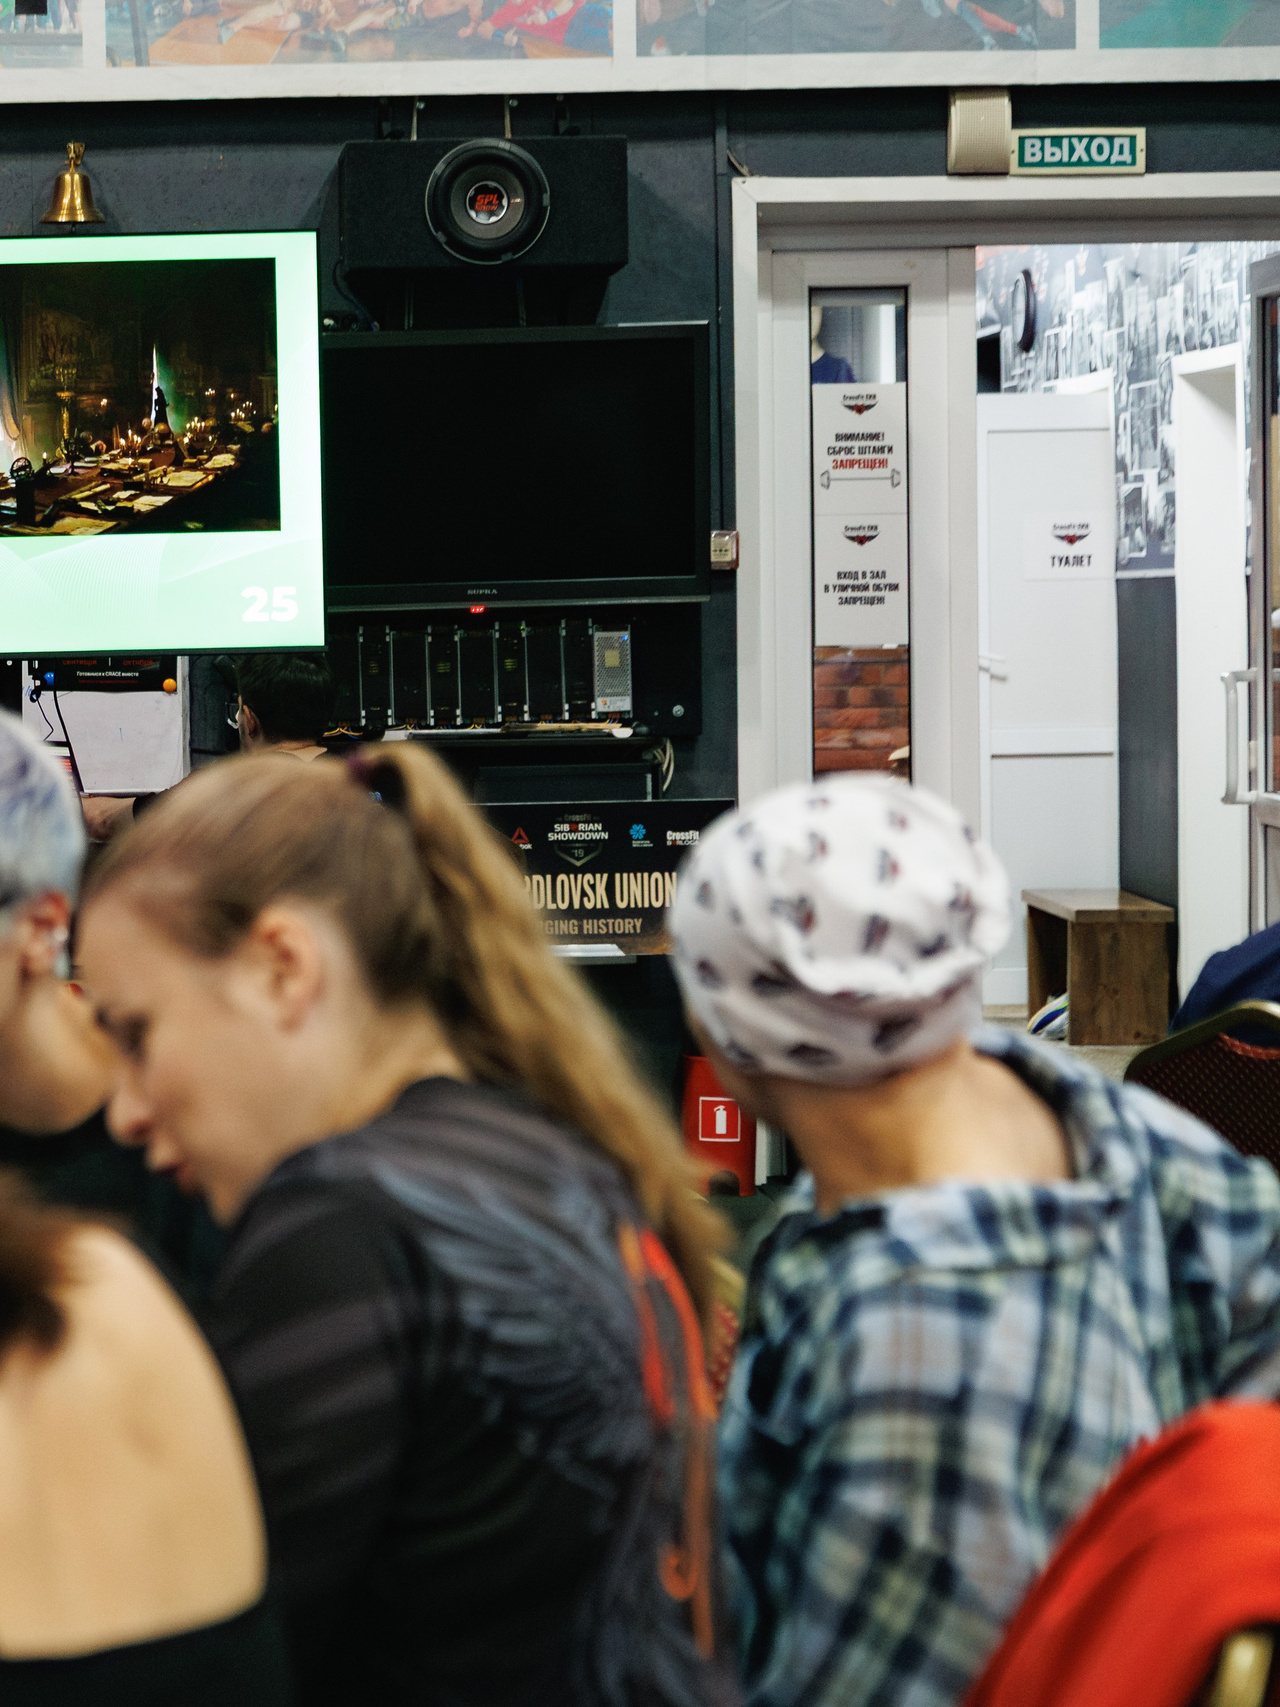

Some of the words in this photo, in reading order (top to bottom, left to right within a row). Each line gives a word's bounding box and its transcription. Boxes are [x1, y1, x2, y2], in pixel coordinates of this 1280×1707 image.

[1023, 136, 1133, 165] ВЫХОД
[475, 193, 500, 205] SPL
[834, 432, 885, 442] ВНИМАНИЕ!
[827, 445, 856, 456] СБРОС
[857, 444, 894, 455] ШТАНГИ
[832, 458, 889, 471] ЗАПРЕЩЕН!
[1050, 554, 1093, 568] ТУАЛЕТ
[837, 570, 860, 581] ВХОД
[861, 571, 867, 580] В
[869, 570, 887, 580] ЗАЛ
[823, 583, 830, 593] В
[832, 581, 870, 593] УЛИЧНОЙ
[872, 582, 900, 592] ОБУВИ
[240, 585, 300, 623] 25
[547, 831, 609, 842] SHOWDOWN
[666, 830, 700, 841] CrossFit
[615, 870, 678, 909] UNION
[582, 917, 644, 935] HISTORY
